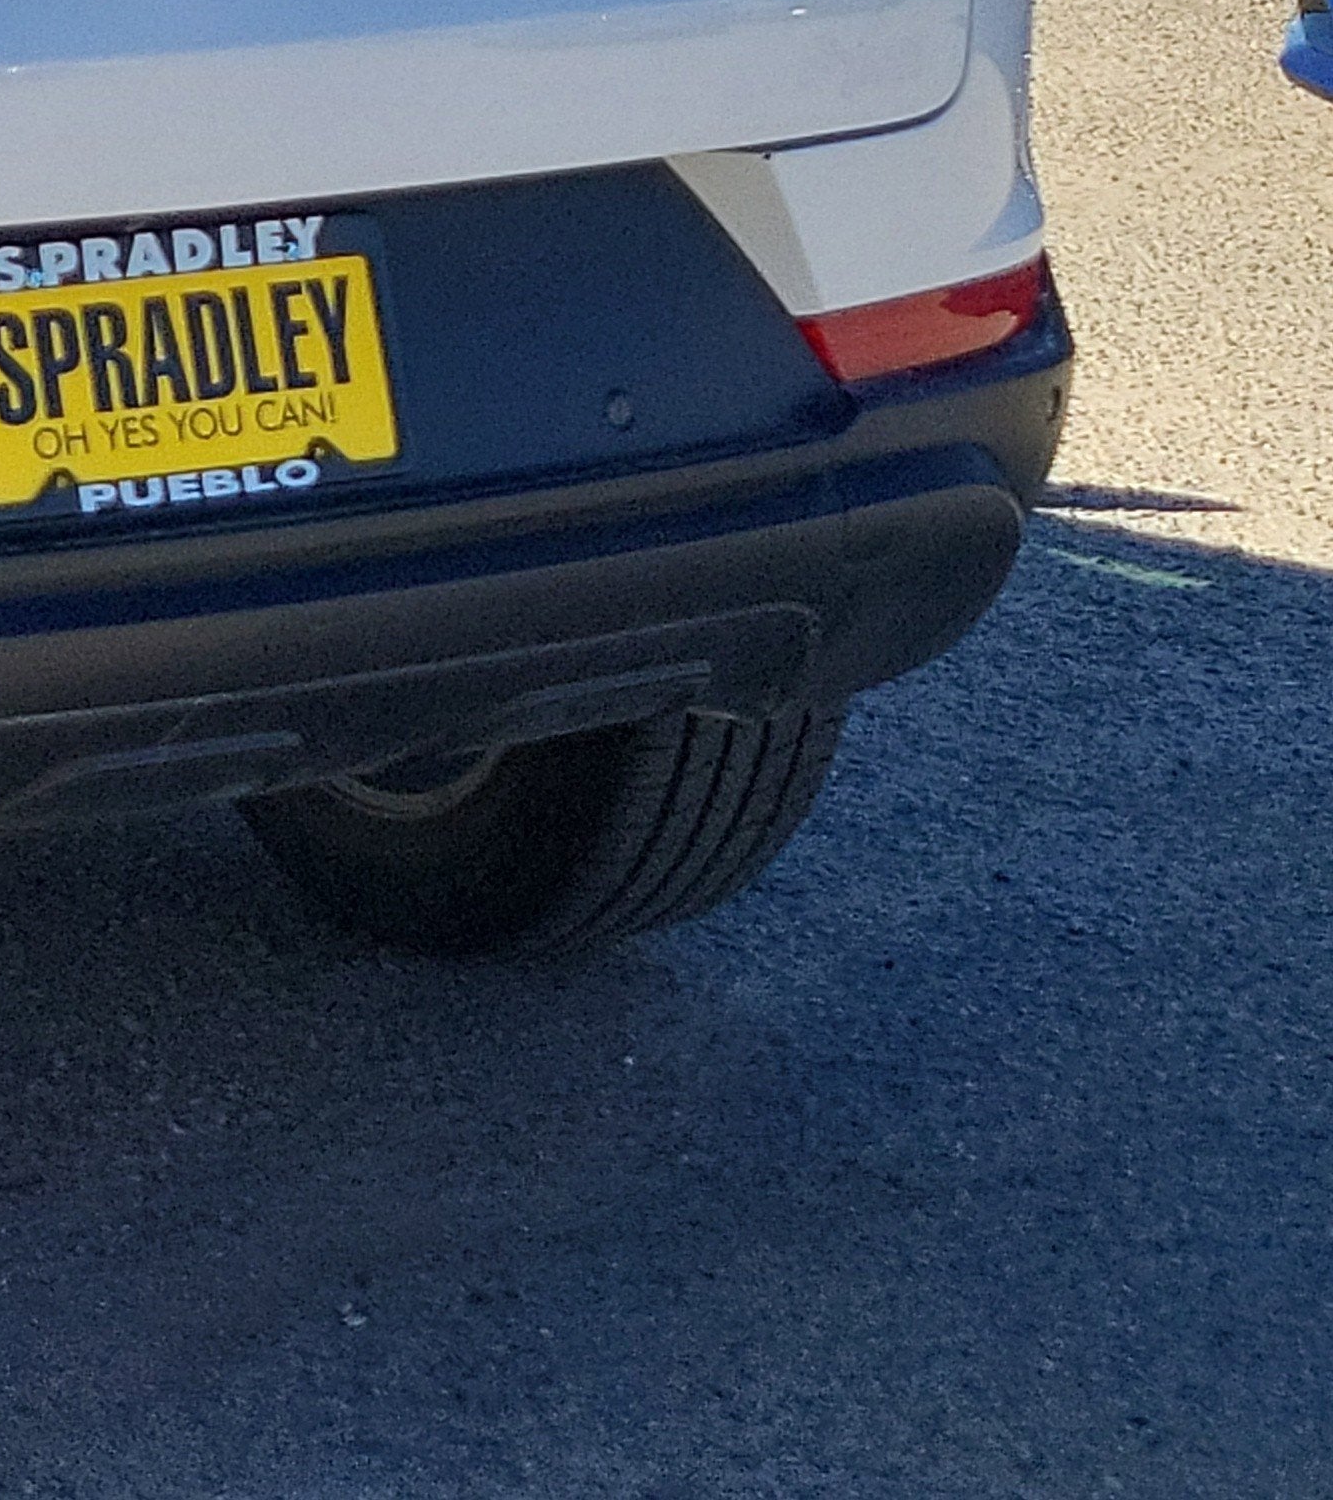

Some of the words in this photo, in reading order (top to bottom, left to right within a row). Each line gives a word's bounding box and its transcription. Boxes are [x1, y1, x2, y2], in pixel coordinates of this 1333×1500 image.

[33, 424, 89, 460] OH
[100, 417, 160, 450] YES
[171, 407, 243, 441] YOU
[255, 393, 338, 431] CAN!
[78, 459, 321, 513] PUEBLO
